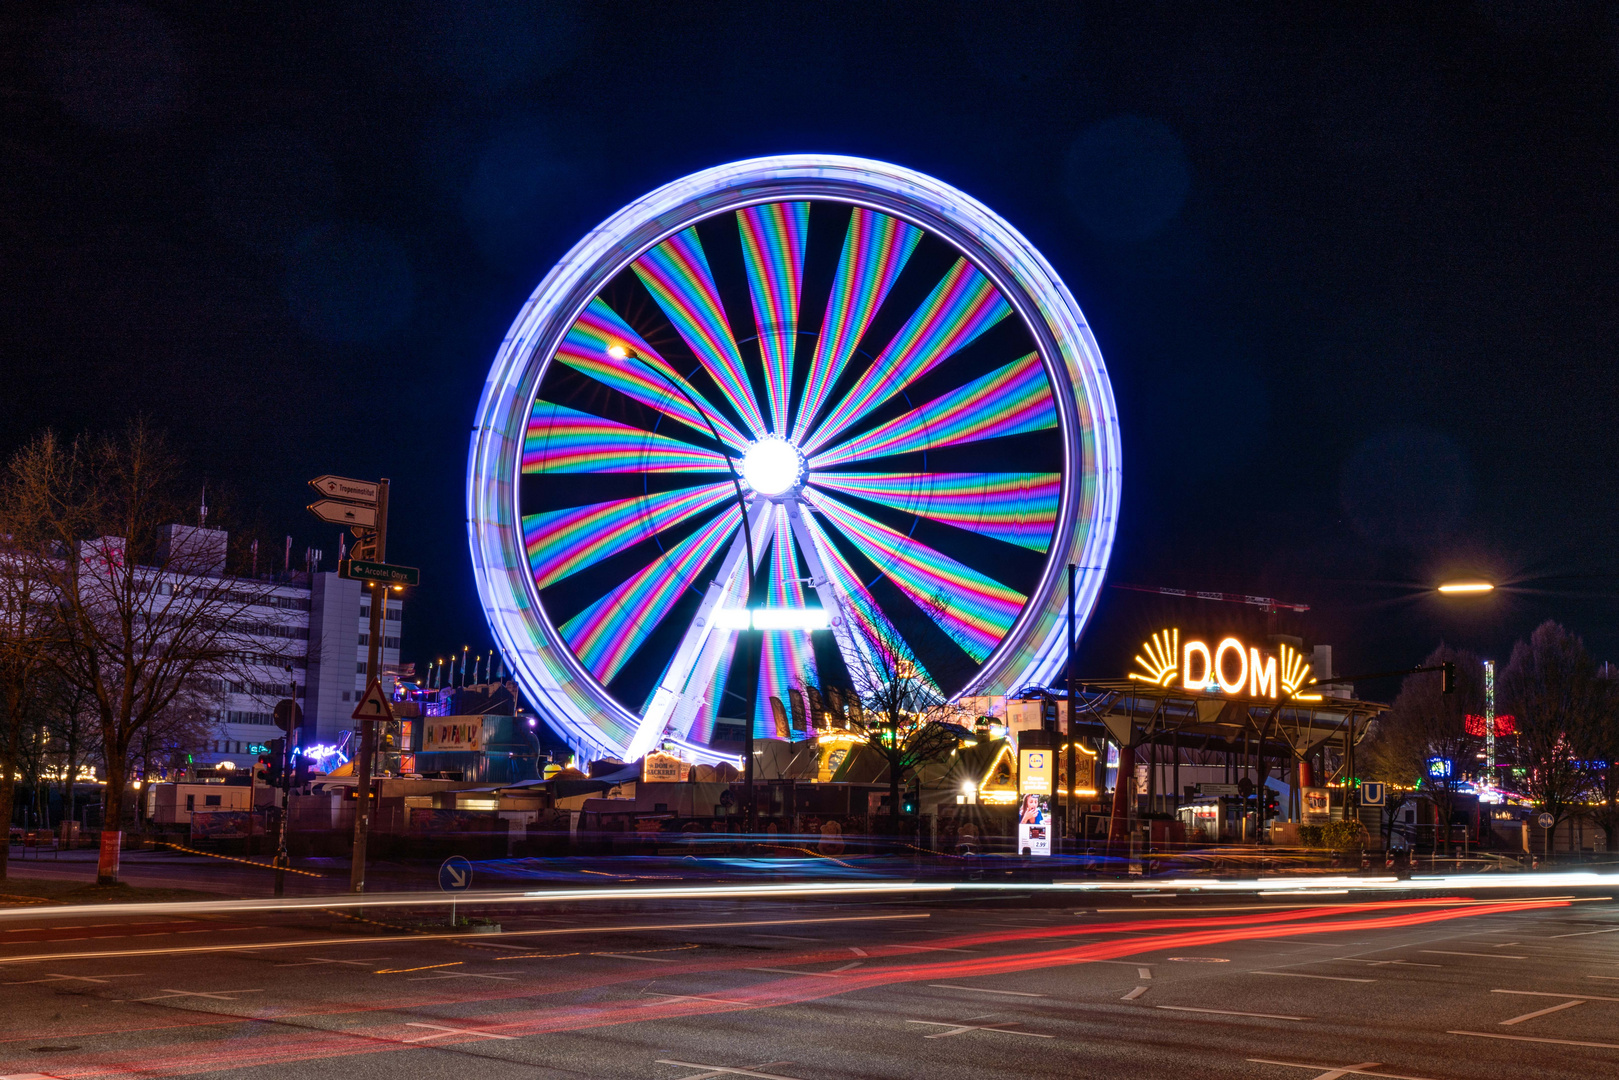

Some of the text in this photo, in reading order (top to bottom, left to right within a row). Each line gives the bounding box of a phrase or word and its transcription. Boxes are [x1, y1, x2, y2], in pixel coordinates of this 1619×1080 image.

[339, 484, 374, 496] Tropeninstitut
[364, 567, 408, 580] Arcotel Onyx
[1183, 637, 1277, 699] DOM
[1364, 784, 1381, 803] U
